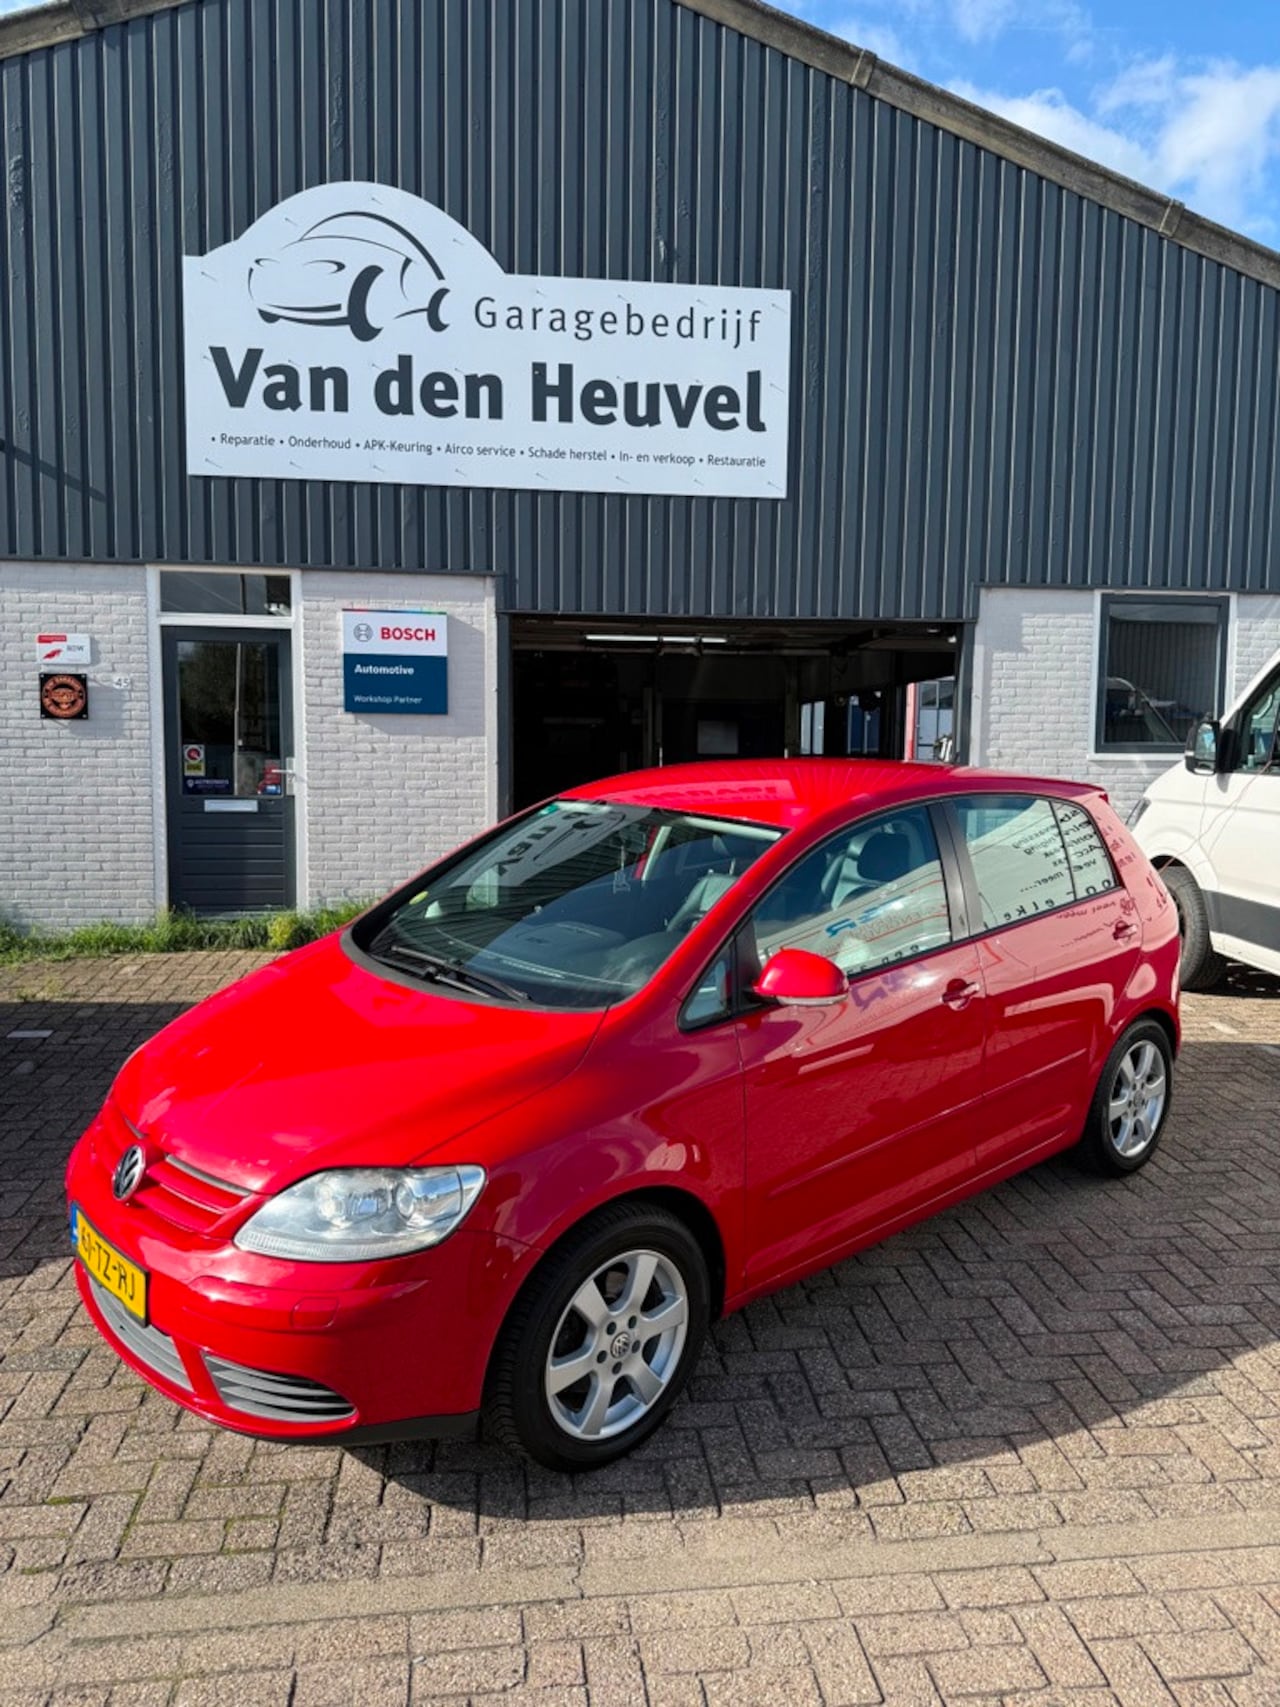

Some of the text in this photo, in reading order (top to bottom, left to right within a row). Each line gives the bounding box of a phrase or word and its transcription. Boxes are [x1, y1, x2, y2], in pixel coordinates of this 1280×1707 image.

[474, 297, 763, 349] Garagebedrijf
[208, 345, 768, 433] Van den Heuvel
[220, 432, 767, 468] Reparatie Onderhoud APK-Keuring Airco service Schade herstel In- en verkoop Restauratie
[380, 626, 437, 642] BOSCH
[353, 663, 415, 676] Automotive
[353, 694, 423, 705] Workshop Partner
